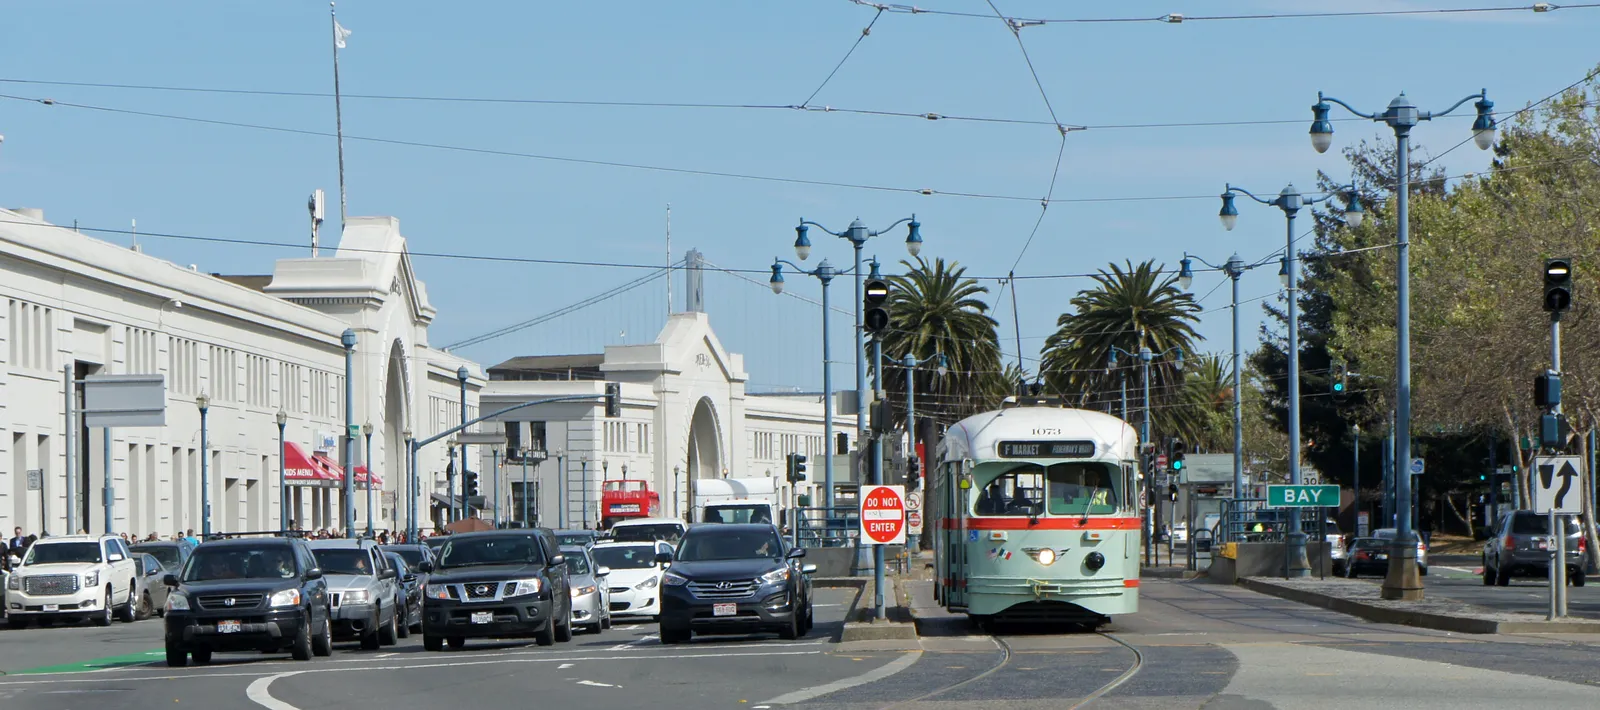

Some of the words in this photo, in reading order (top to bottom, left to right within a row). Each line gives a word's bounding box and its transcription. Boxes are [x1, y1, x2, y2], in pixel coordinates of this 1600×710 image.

[1004, 444, 1011, 455] F
[1012, 444, 1040, 455] MARKET
[297, 468, 314, 477] MENU
[1303, 477, 1317, 485] 30
[1284, 489, 1323, 503] BAY
[867, 498, 879, 507] DO
[882, 498, 898, 507] NOT
[870, 522, 896, 532] ENTER
